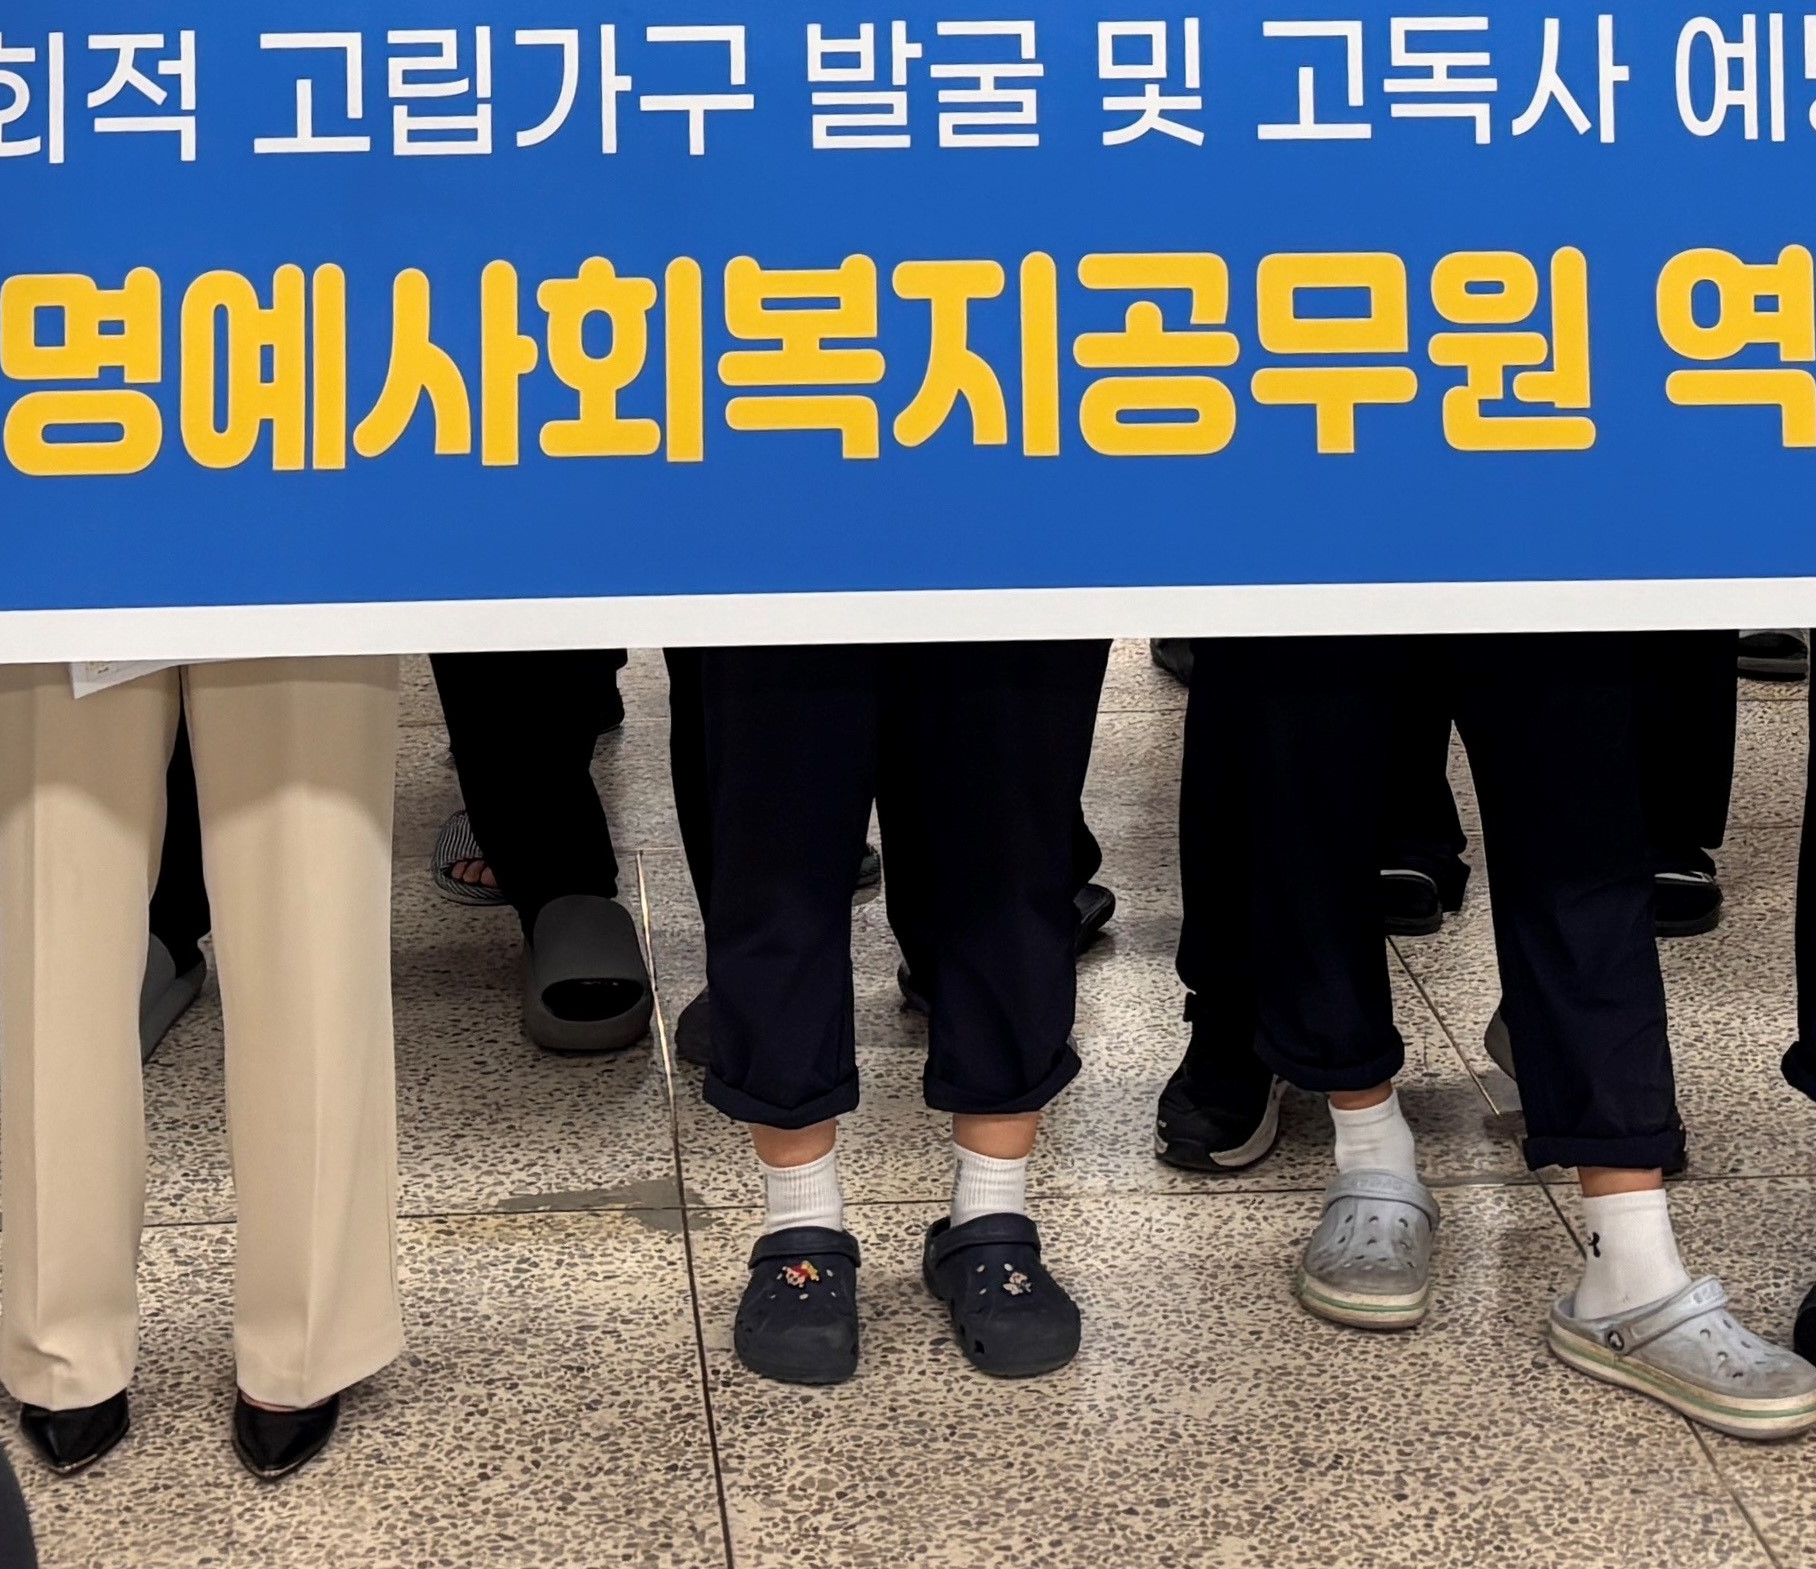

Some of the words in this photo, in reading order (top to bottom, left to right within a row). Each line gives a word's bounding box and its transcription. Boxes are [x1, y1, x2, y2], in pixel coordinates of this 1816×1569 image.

[253, 23, 755, 156] 고립가구
[806, 20, 1045, 150] 발굴
[1097, 17, 1205, 146] 및
[1257, 14, 1630, 145] 고독사
